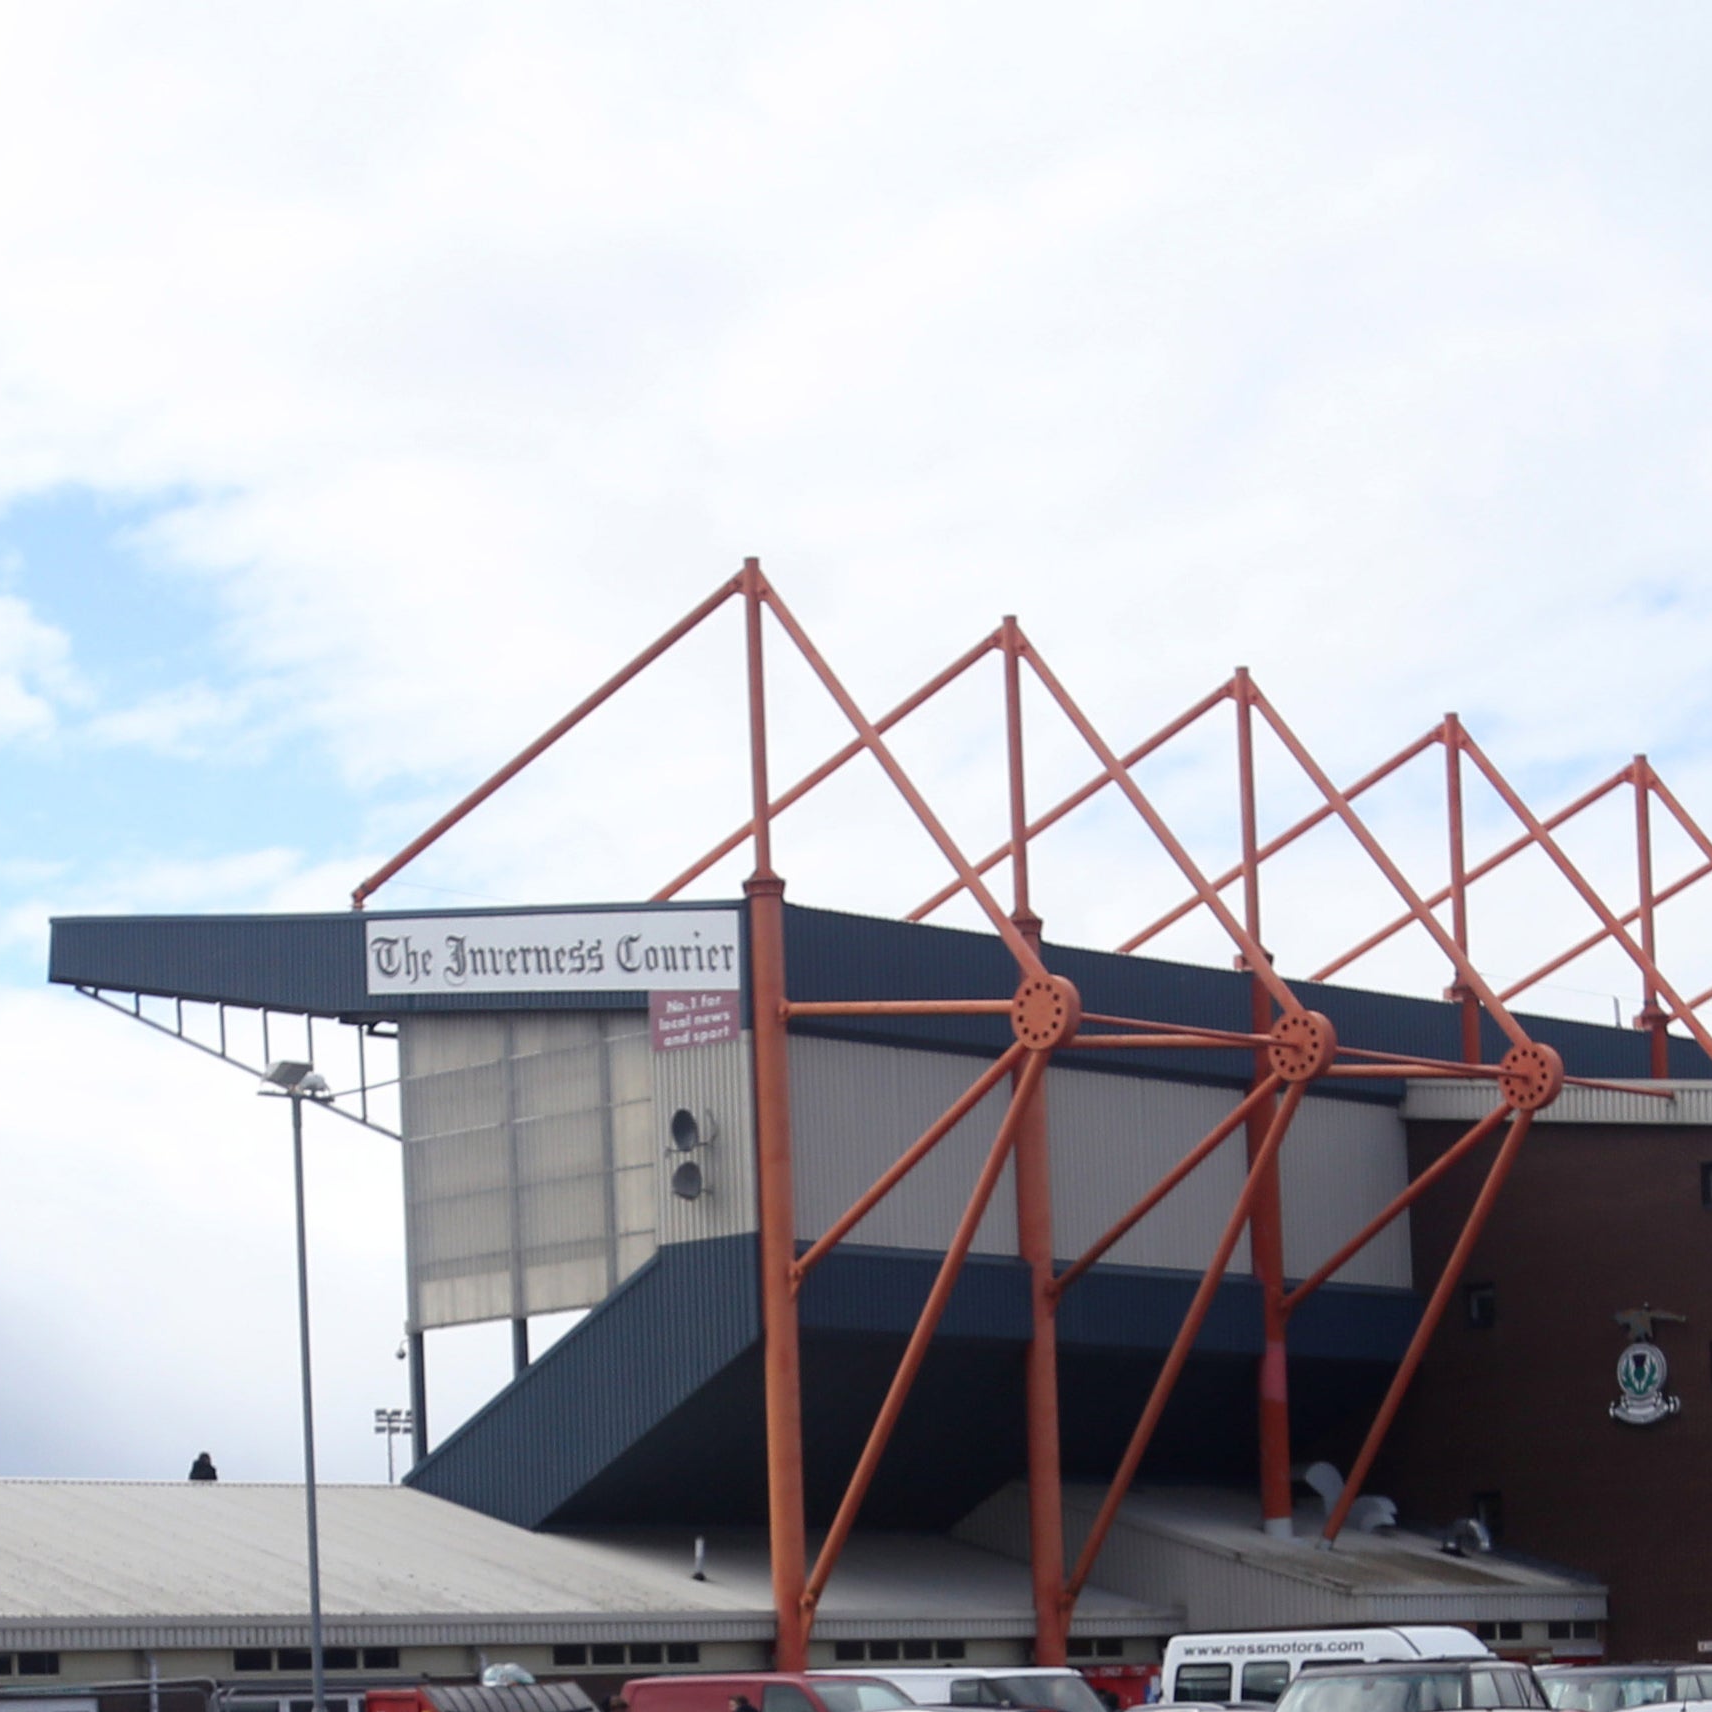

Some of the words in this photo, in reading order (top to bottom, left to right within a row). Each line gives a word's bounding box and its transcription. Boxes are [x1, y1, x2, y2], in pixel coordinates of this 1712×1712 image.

[370, 936, 433, 984] The
[444, 935, 605, 986] Inverness
[616, 930, 735, 973] Courier
[701, 993, 721, 1008] for
[658, 1013, 692, 1031] local
[694, 1011, 730, 1025] news
[663, 1029, 690, 1047] and
[693, 1025, 730, 1043] sport
[1183, 1640, 1365, 1656] www.nessmotors.com
